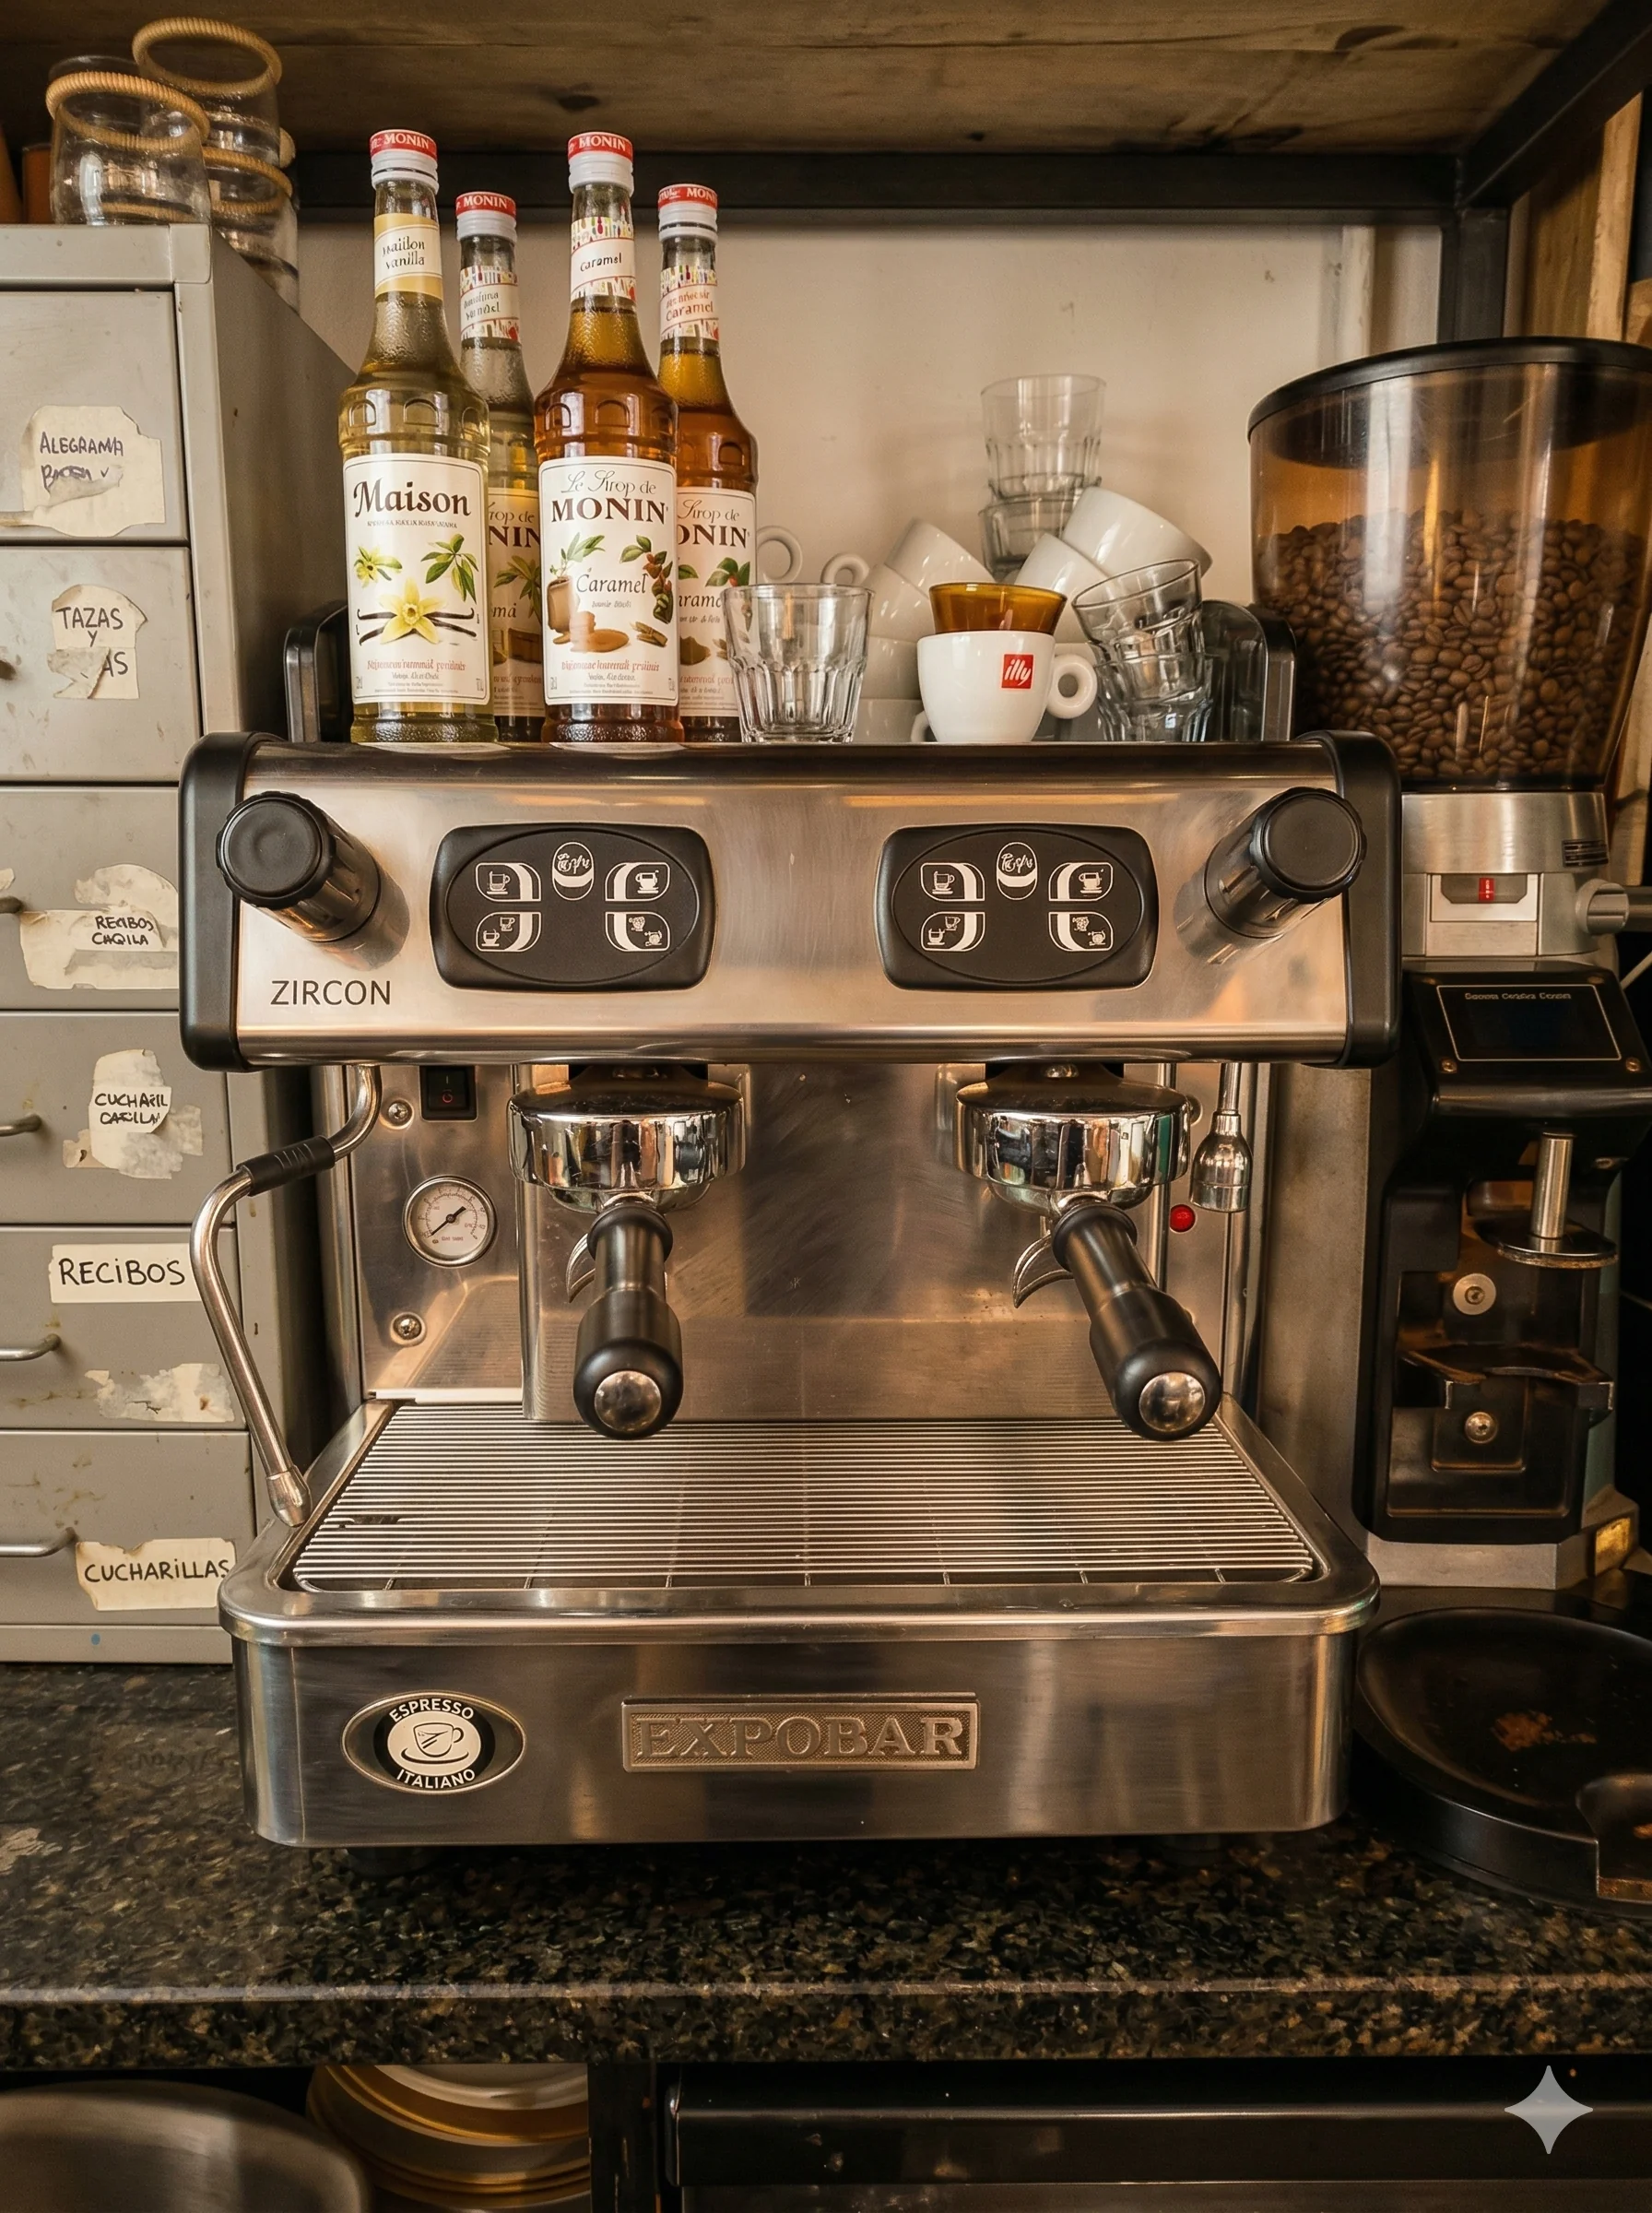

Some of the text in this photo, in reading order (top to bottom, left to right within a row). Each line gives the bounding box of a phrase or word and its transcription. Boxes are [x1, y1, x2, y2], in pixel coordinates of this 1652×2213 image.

[384, 132, 431, 149] MONIN
[578, 135, 626, 152] MONIN
[463, 195, 508, 209] MONIN
[353, 476, 471, 518] Maison
[639, 480, 656, 495] de
[518, 510, 535, 524] de
[550, 497, 666, 525] MONIN
[725, 508, 739, 522] de
[55, 606, 124, 631] TAZAS
[1004, 658, 1032, 686] illy
[270, 979, 391, 1006] ZIRCON
[388, 1698, 475, 1723] ESPRESSO
[636, 1715, 964, 1758] EXPOBAR
[395, 1768, 477, 1790] ITALIANO
